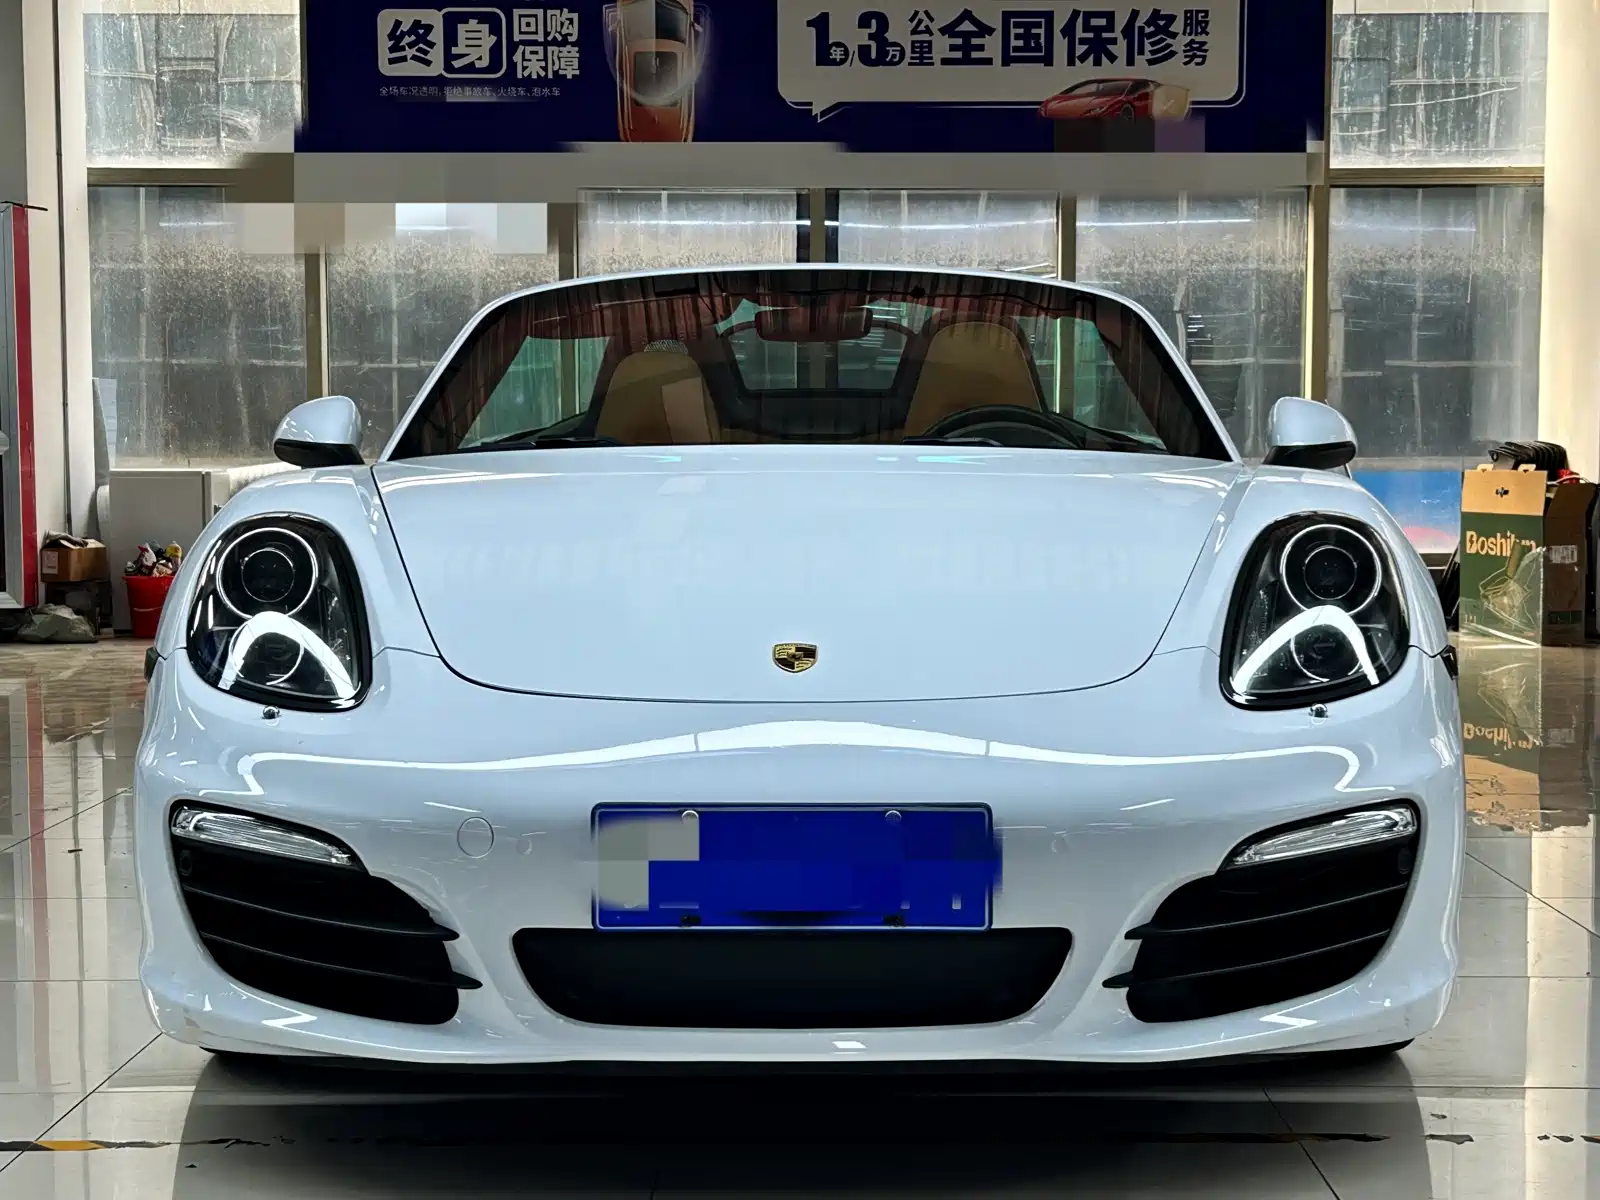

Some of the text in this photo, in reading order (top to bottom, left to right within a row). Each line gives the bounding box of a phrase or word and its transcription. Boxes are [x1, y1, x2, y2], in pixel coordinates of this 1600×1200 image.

[386, 18, 498, 69] 终身
[512, 8, 579, 42] 回购
[937, 8, 1180, 68] 全国保修
[512, 45, 580, 79] 保障
